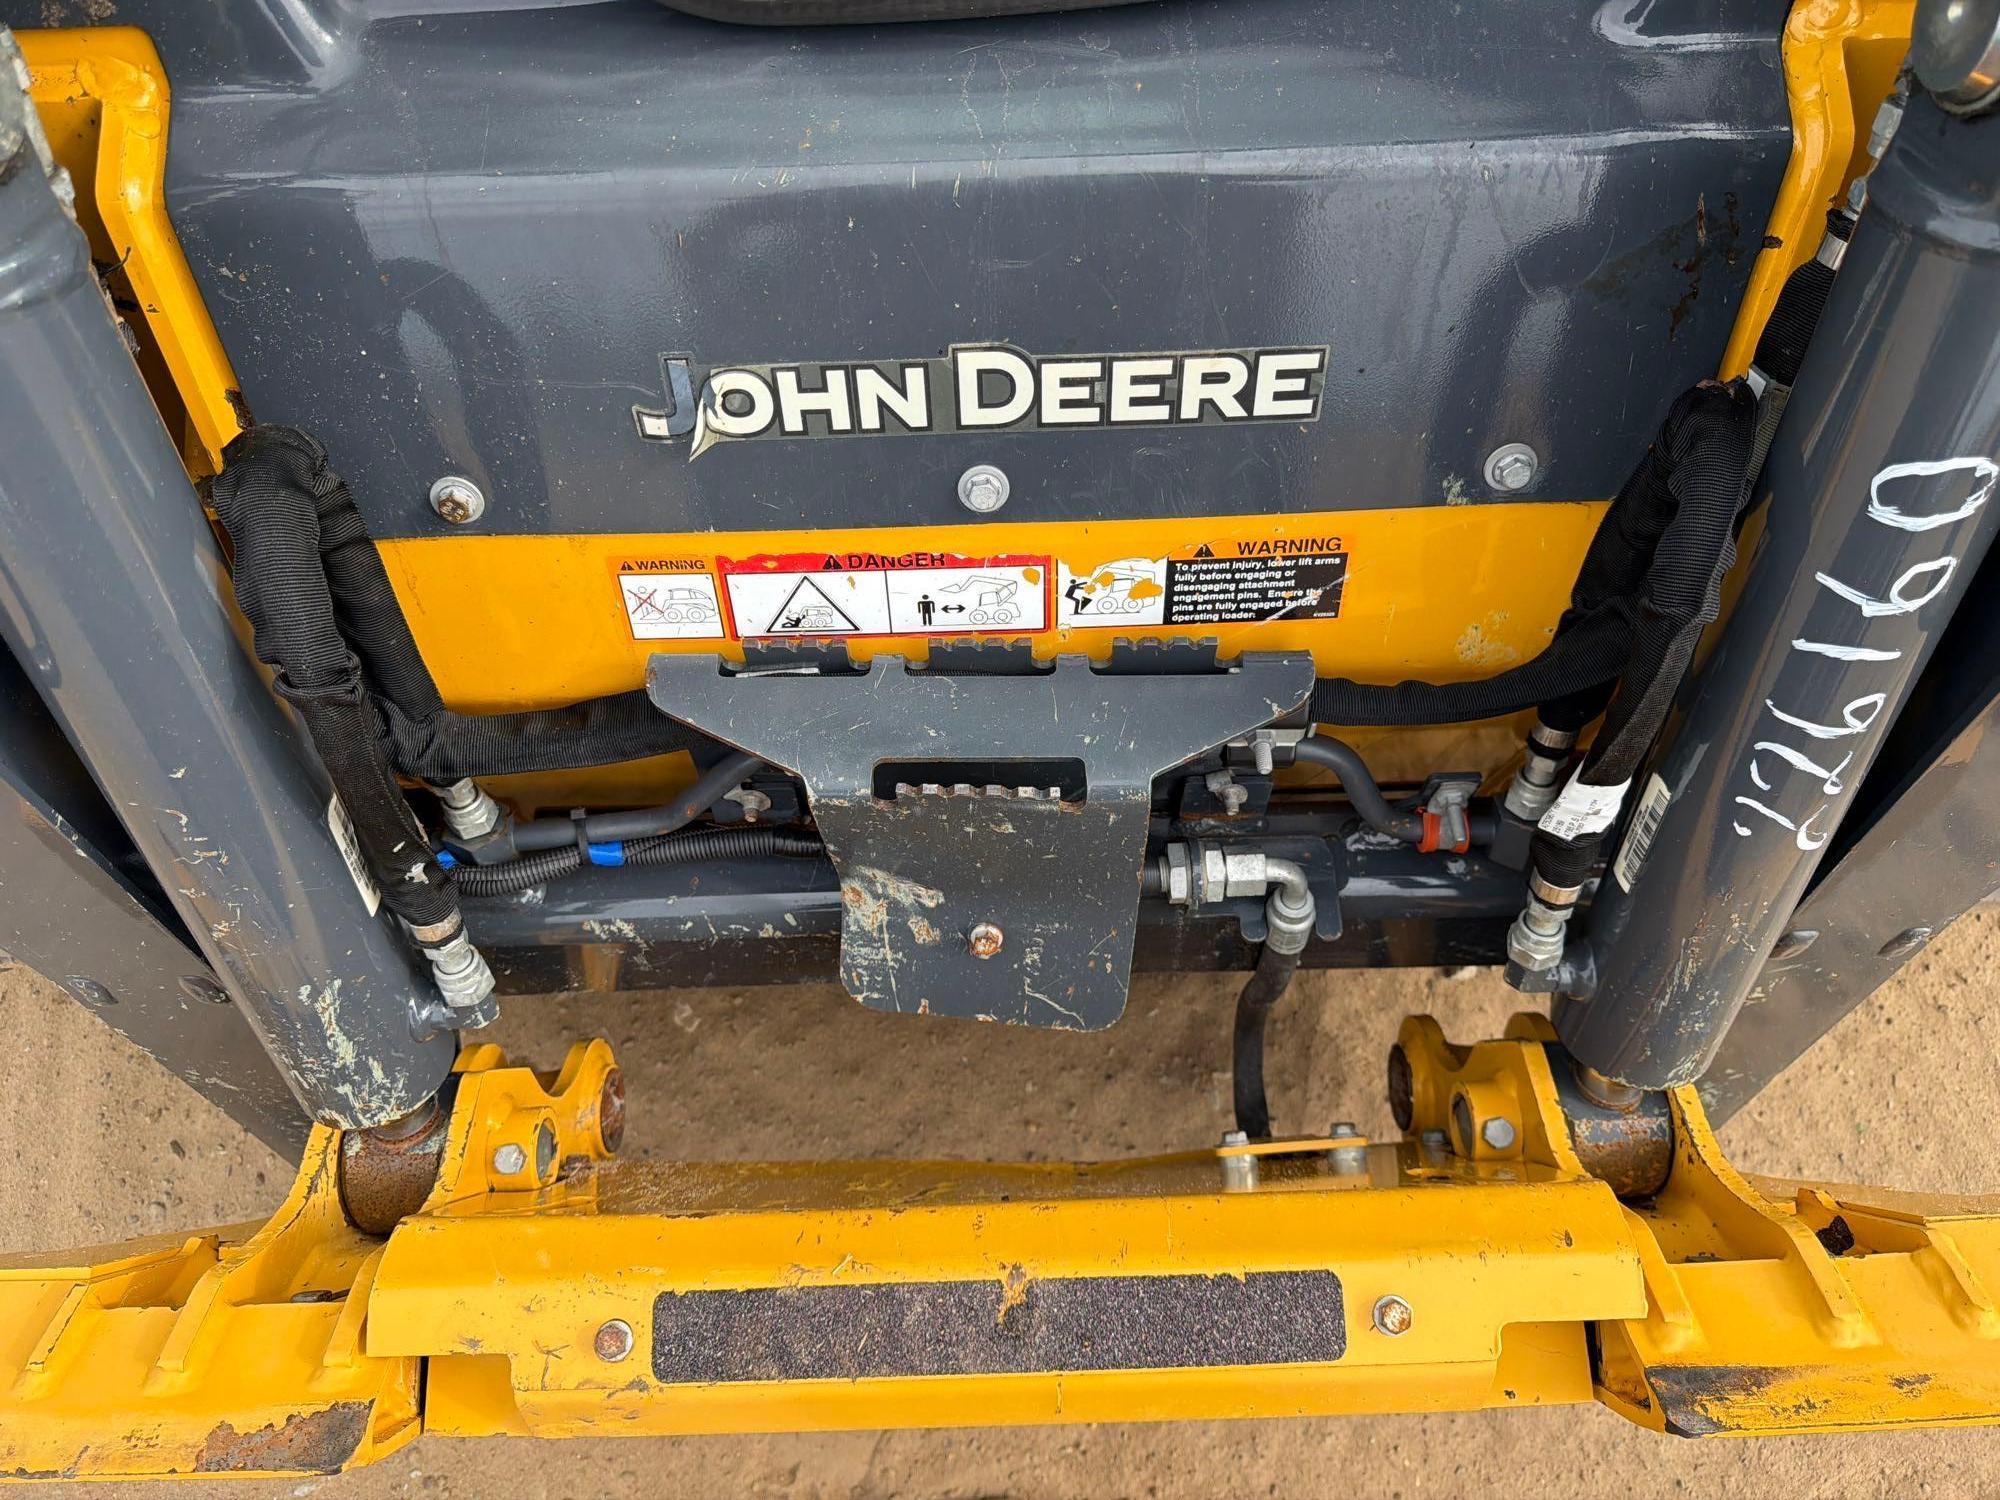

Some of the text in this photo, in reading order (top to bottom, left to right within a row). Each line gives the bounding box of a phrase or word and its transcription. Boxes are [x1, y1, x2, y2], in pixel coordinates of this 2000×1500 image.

[638, 347, 1325, 439] JOHN DEERE
[1237, 537, 1342, 556] WARNING
[635, 559, 706, 571] WARNING
[848, 552, 945, 569] DANGER
[1175, 563, 1189, 571] To
[1191, 561, 1231, 571] prevent
[1267, 559, 1297, 568] lower
[1298, 557, 1313, 566] lift
[1314, 557, 1341, 566] arms
[1174, 573, 1197, 582] fully
[1199, 572, 1232, 581] before
[1234, 570, 1282, 580] engaging
[1173, 579, 1296, 592] disengaging attachment
[1172, 592, 1235, 603] engagement
[1237, 591, 1262, 601] pins.
[1267, 590, 1304, 598] Ensre
[1172, 599, 1318, 613] pins are fully engaged before
[1171, 613, 1219, 622] operating
[1733, 457, 1998, 850] 226160
